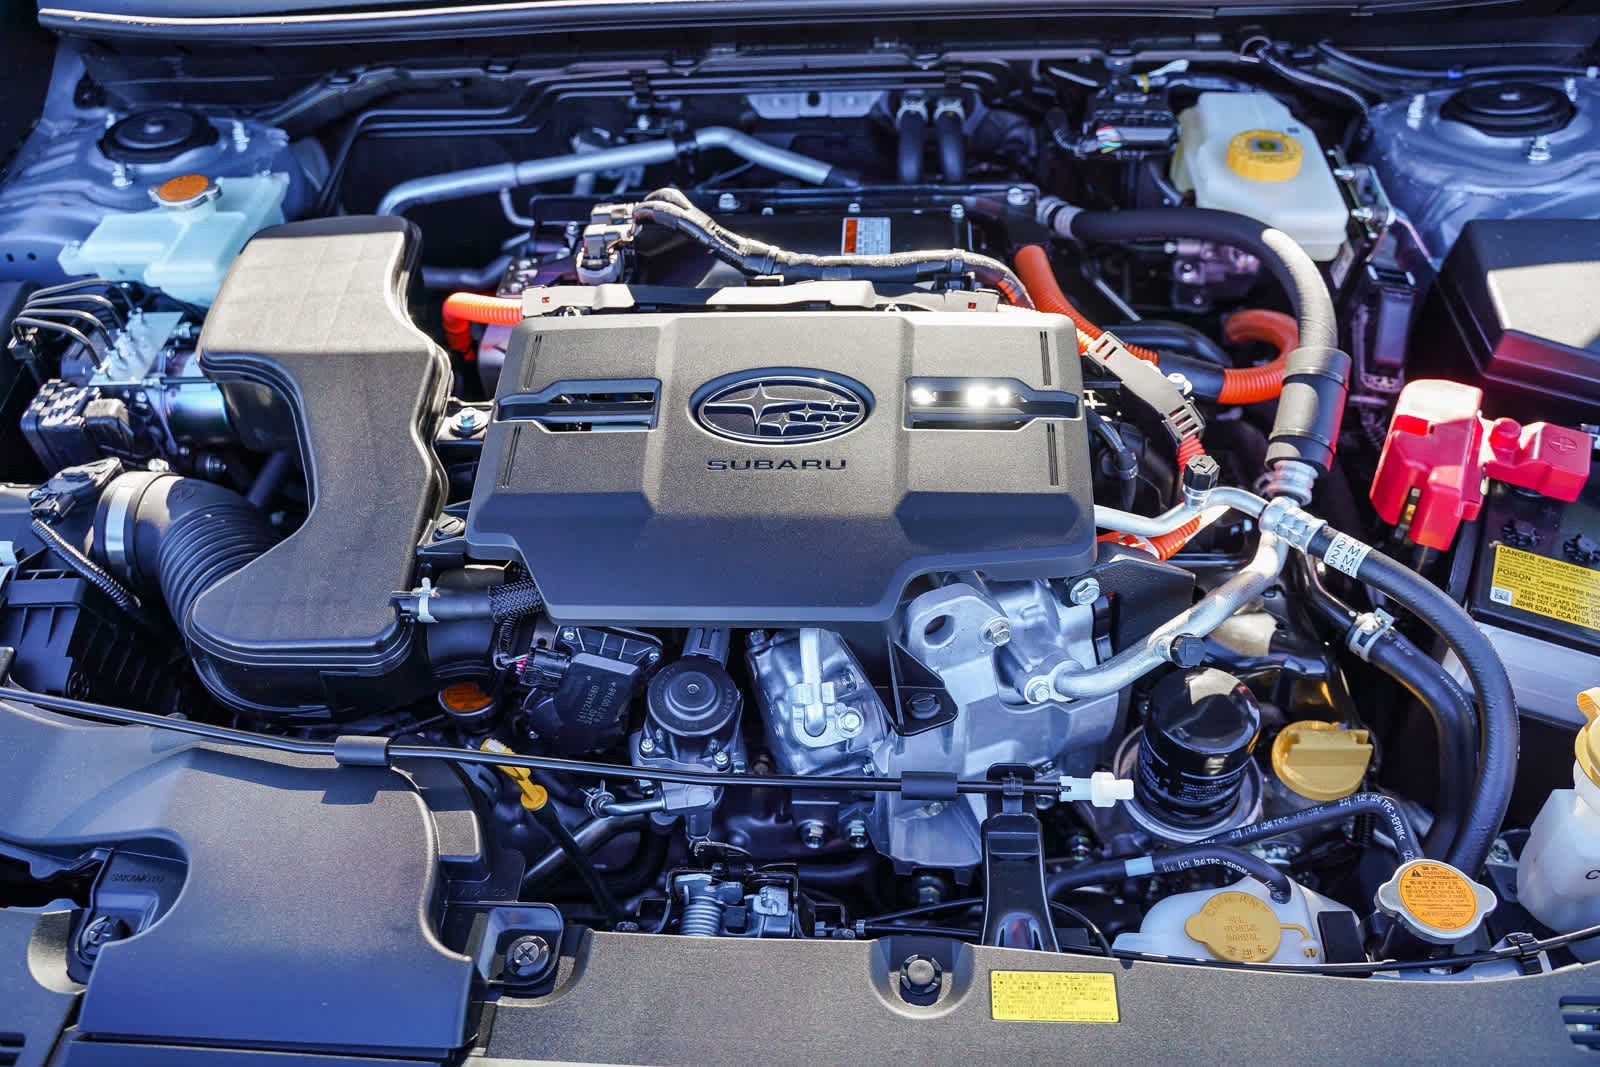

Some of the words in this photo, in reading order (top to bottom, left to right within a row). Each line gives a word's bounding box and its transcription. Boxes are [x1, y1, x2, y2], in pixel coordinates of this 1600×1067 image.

[706, 458, 846, 471] SUBARU
[1499, 546, 1536, 561] DANGER
[1497, 566, 1532, 582] POISON
[1555, 610, 1572, 620] CCA
